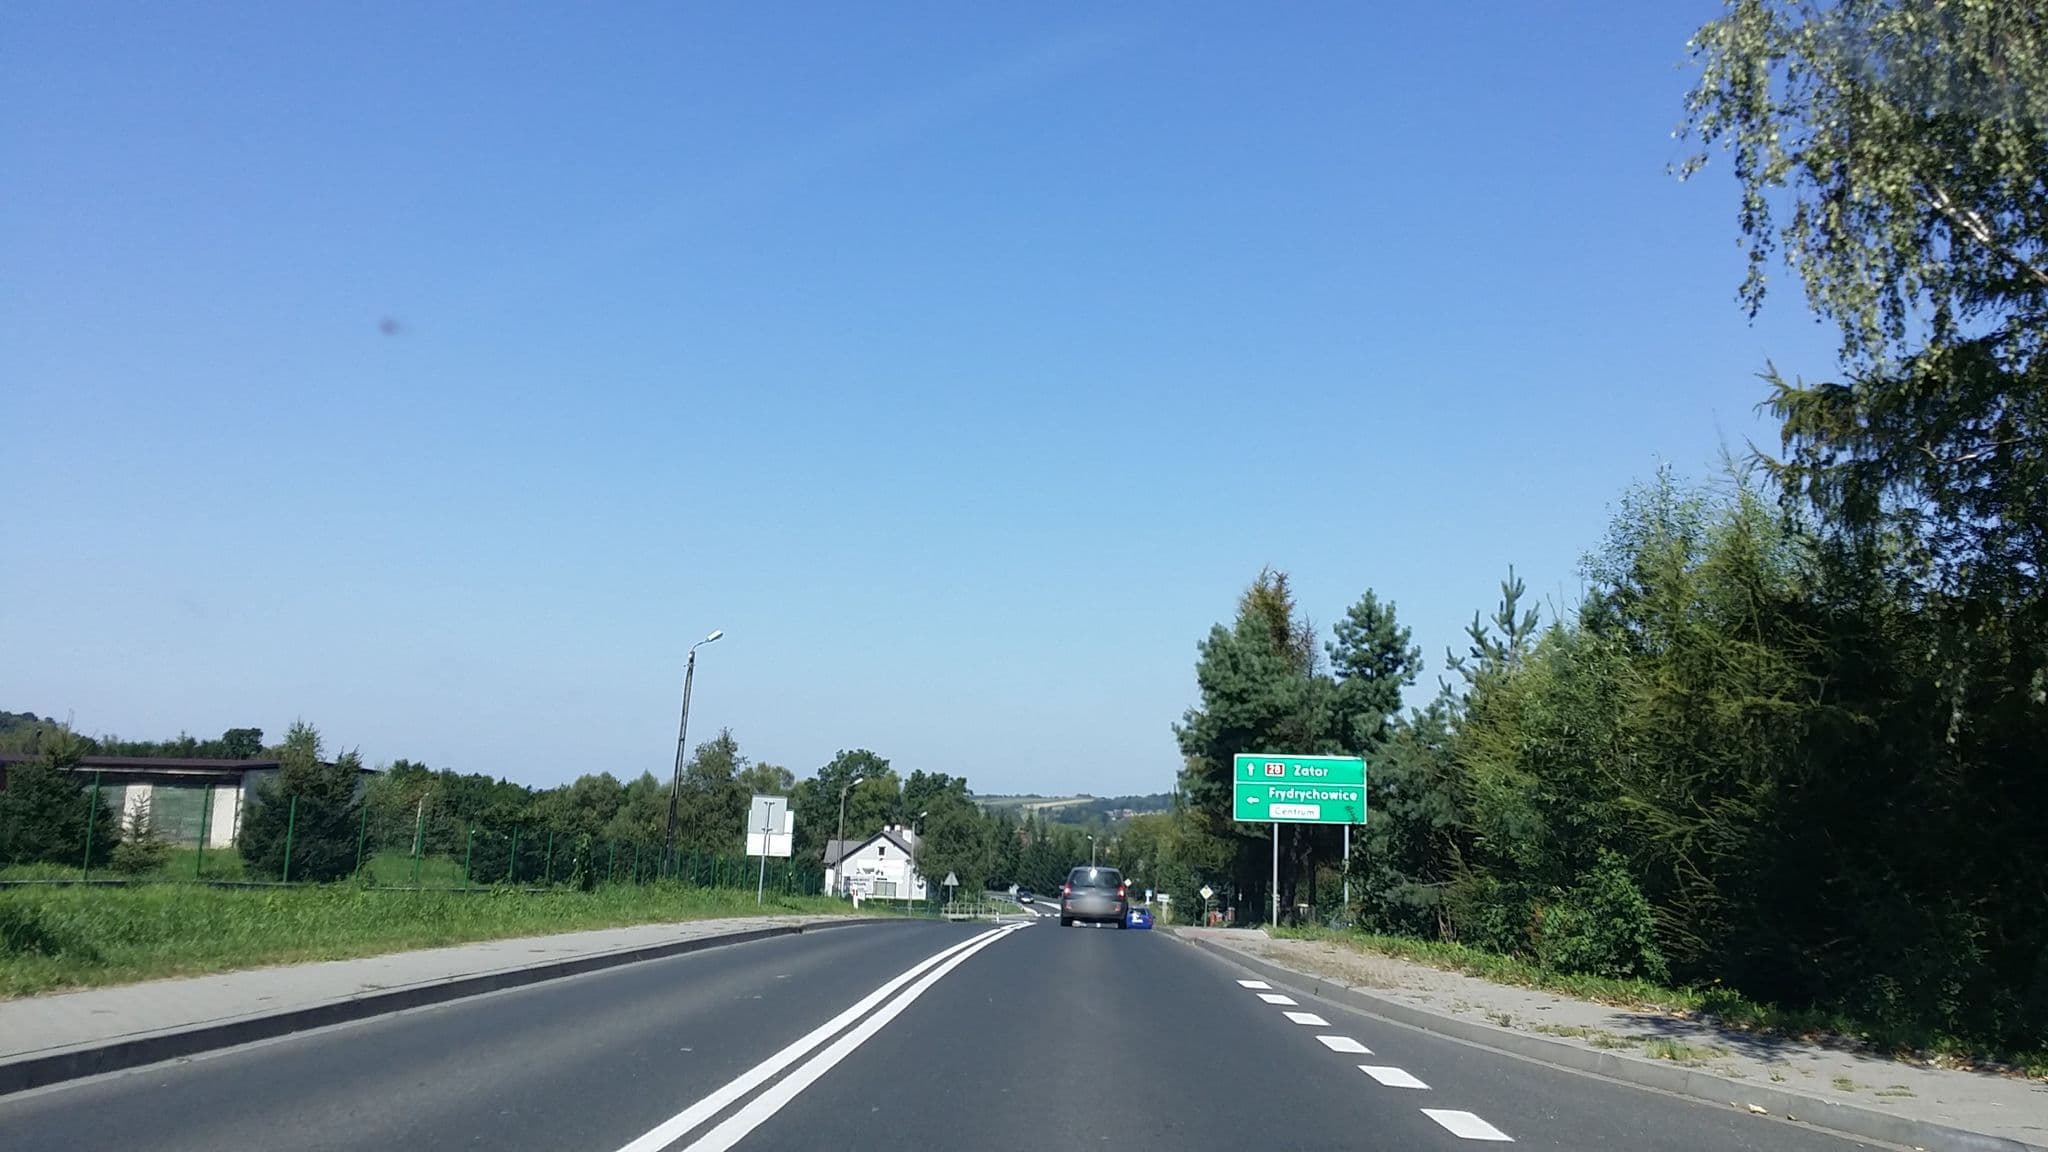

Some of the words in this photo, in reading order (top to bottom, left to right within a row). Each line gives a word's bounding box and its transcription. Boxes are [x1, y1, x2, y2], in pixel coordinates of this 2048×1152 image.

[1268, 765, 1282, 774] 28
[1293, 765, 1329, 777] Zator
[1268, 787, 1358, 802] Frydrychowice
[1274, 807, 1315, 816] Centrum
